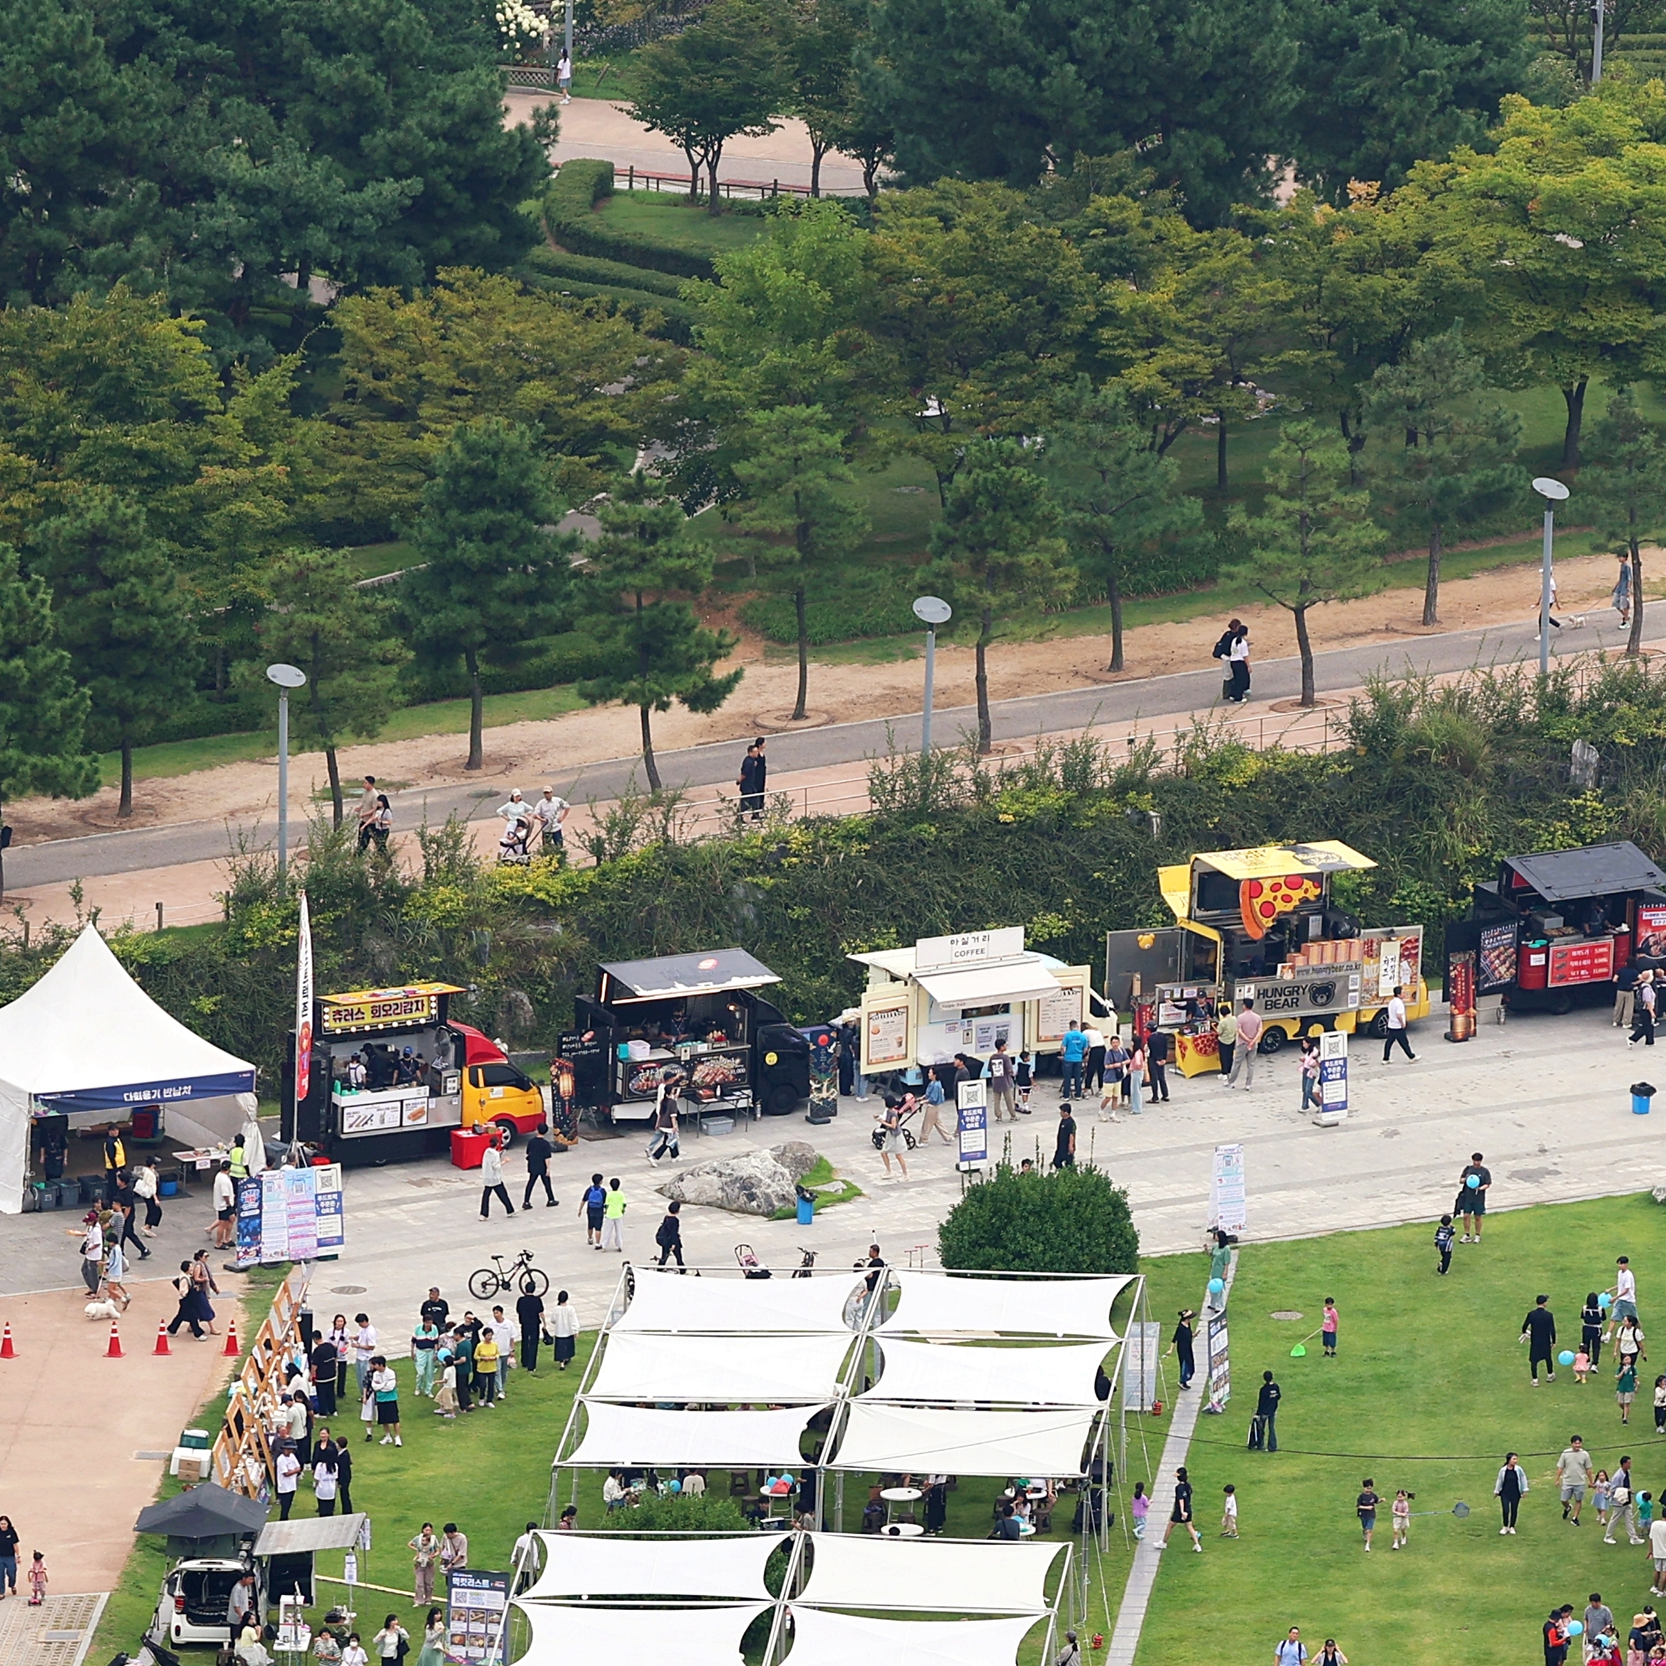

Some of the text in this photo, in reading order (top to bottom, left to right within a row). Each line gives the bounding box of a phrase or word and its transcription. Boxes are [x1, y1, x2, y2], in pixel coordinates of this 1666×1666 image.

[954, 948, 986, 958] COFFEE
[1257, 984, 1308, 999] HUNGRY
[332, 999, 425, 1023] 츄러스 회오리감자
[1264, 997, 1300, 1010] BEAR
[123, 1087, 161, 1102] 다회용기
